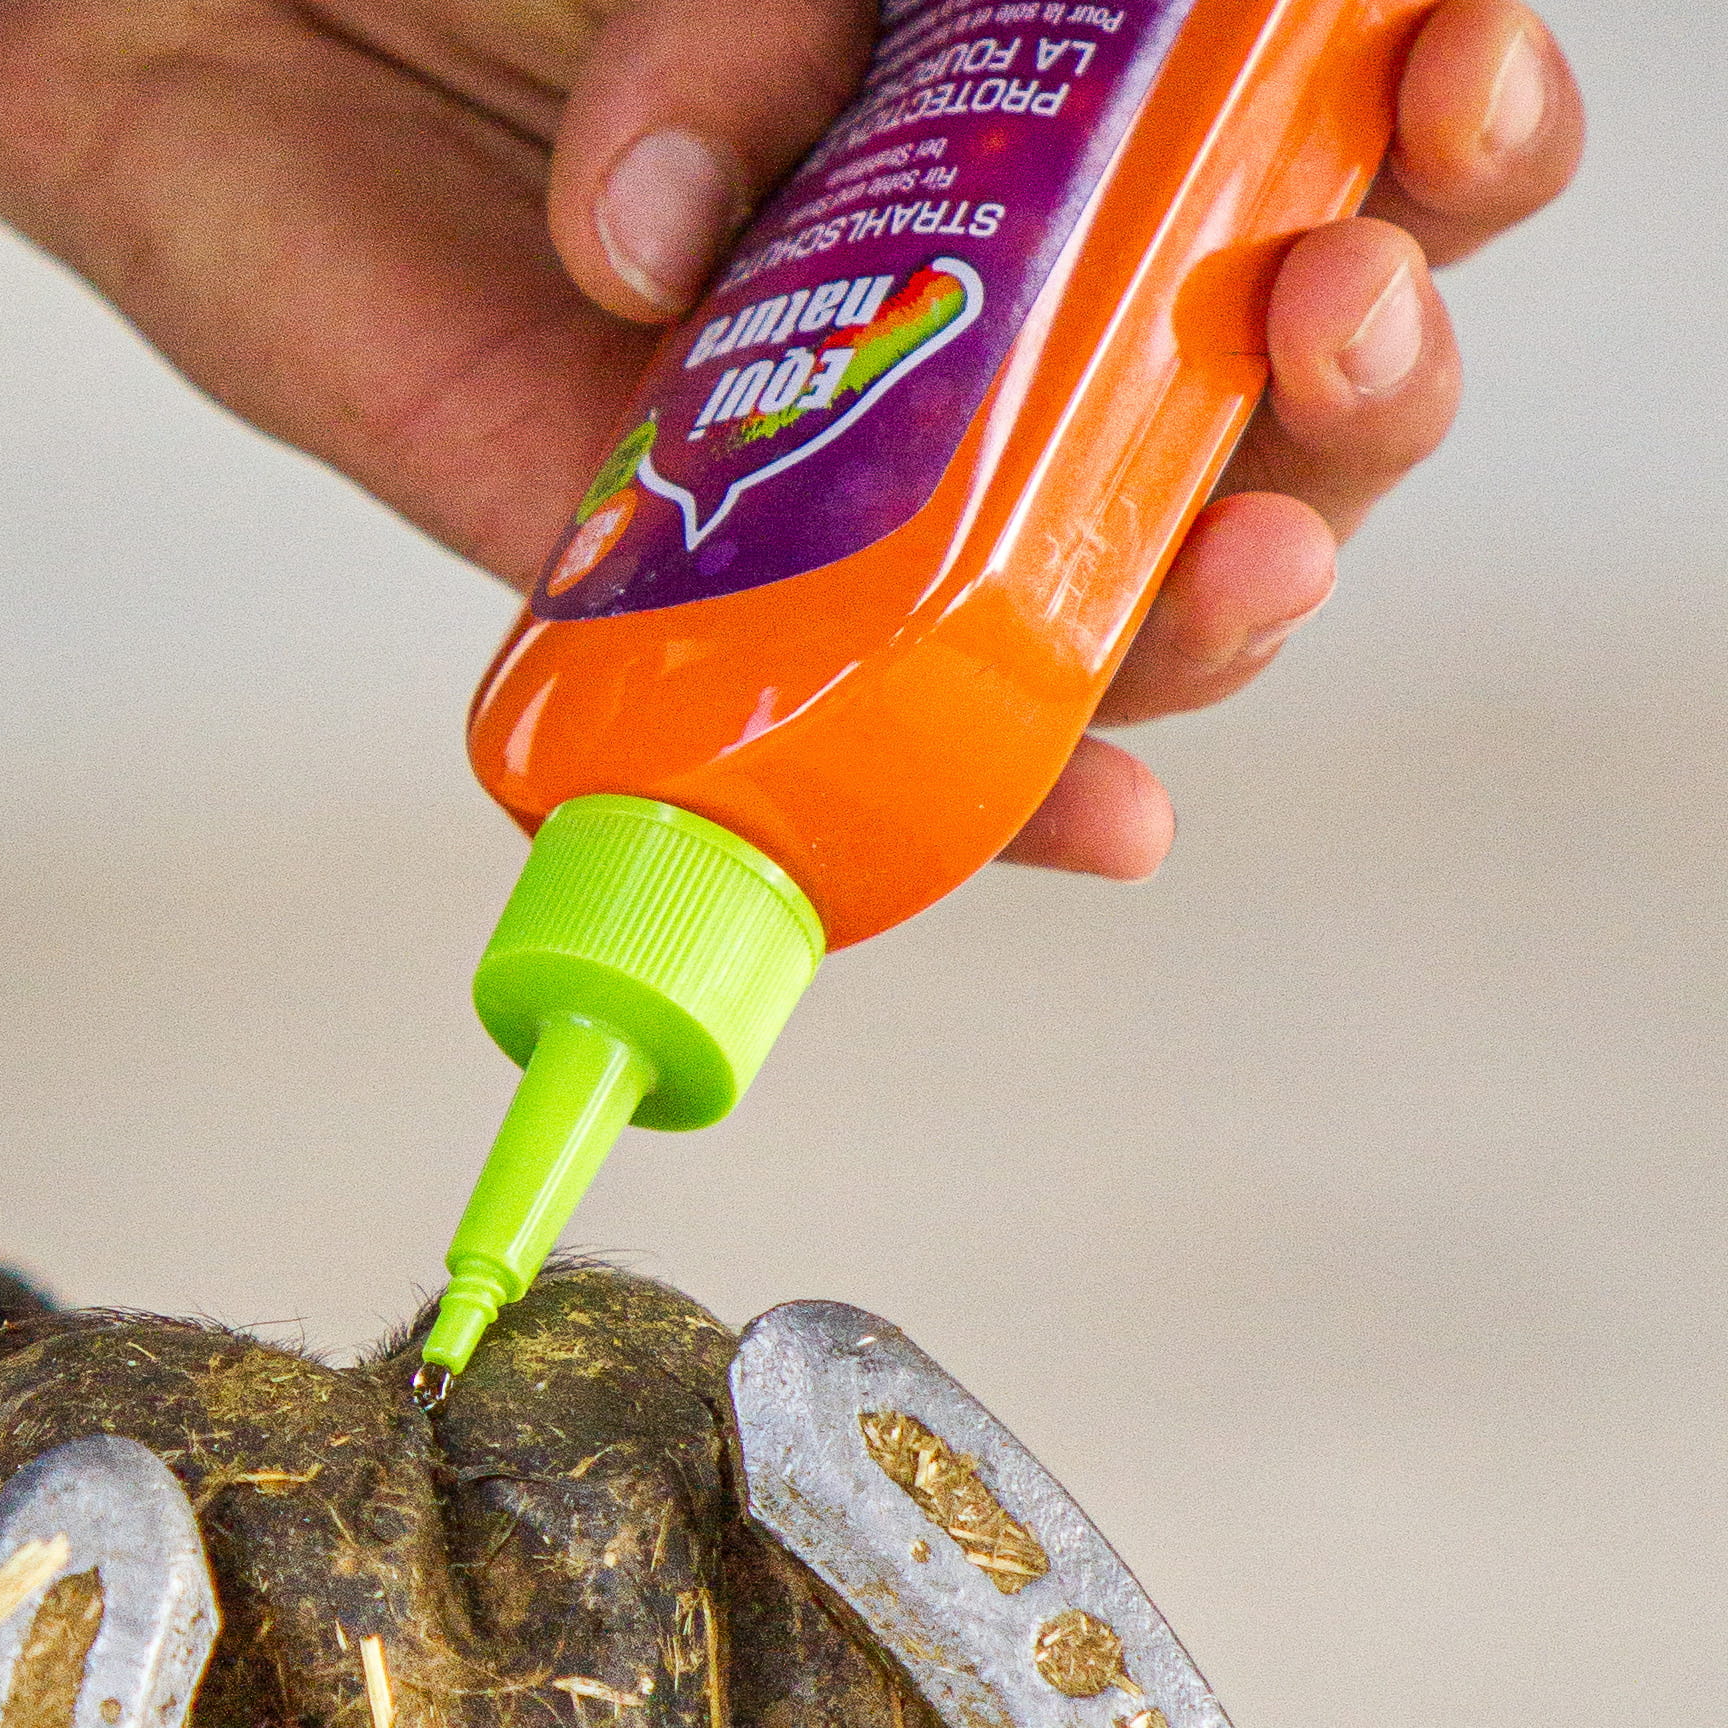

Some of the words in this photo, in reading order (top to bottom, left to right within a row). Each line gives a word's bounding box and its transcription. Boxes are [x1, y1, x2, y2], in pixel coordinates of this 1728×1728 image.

[1066, 4, 1126, 34] Pour
[1036, 37, 1098, 77] LA
[717, 200, 1007, 295] STRAHLSCHU
[685, 275, 895, 369] natura
